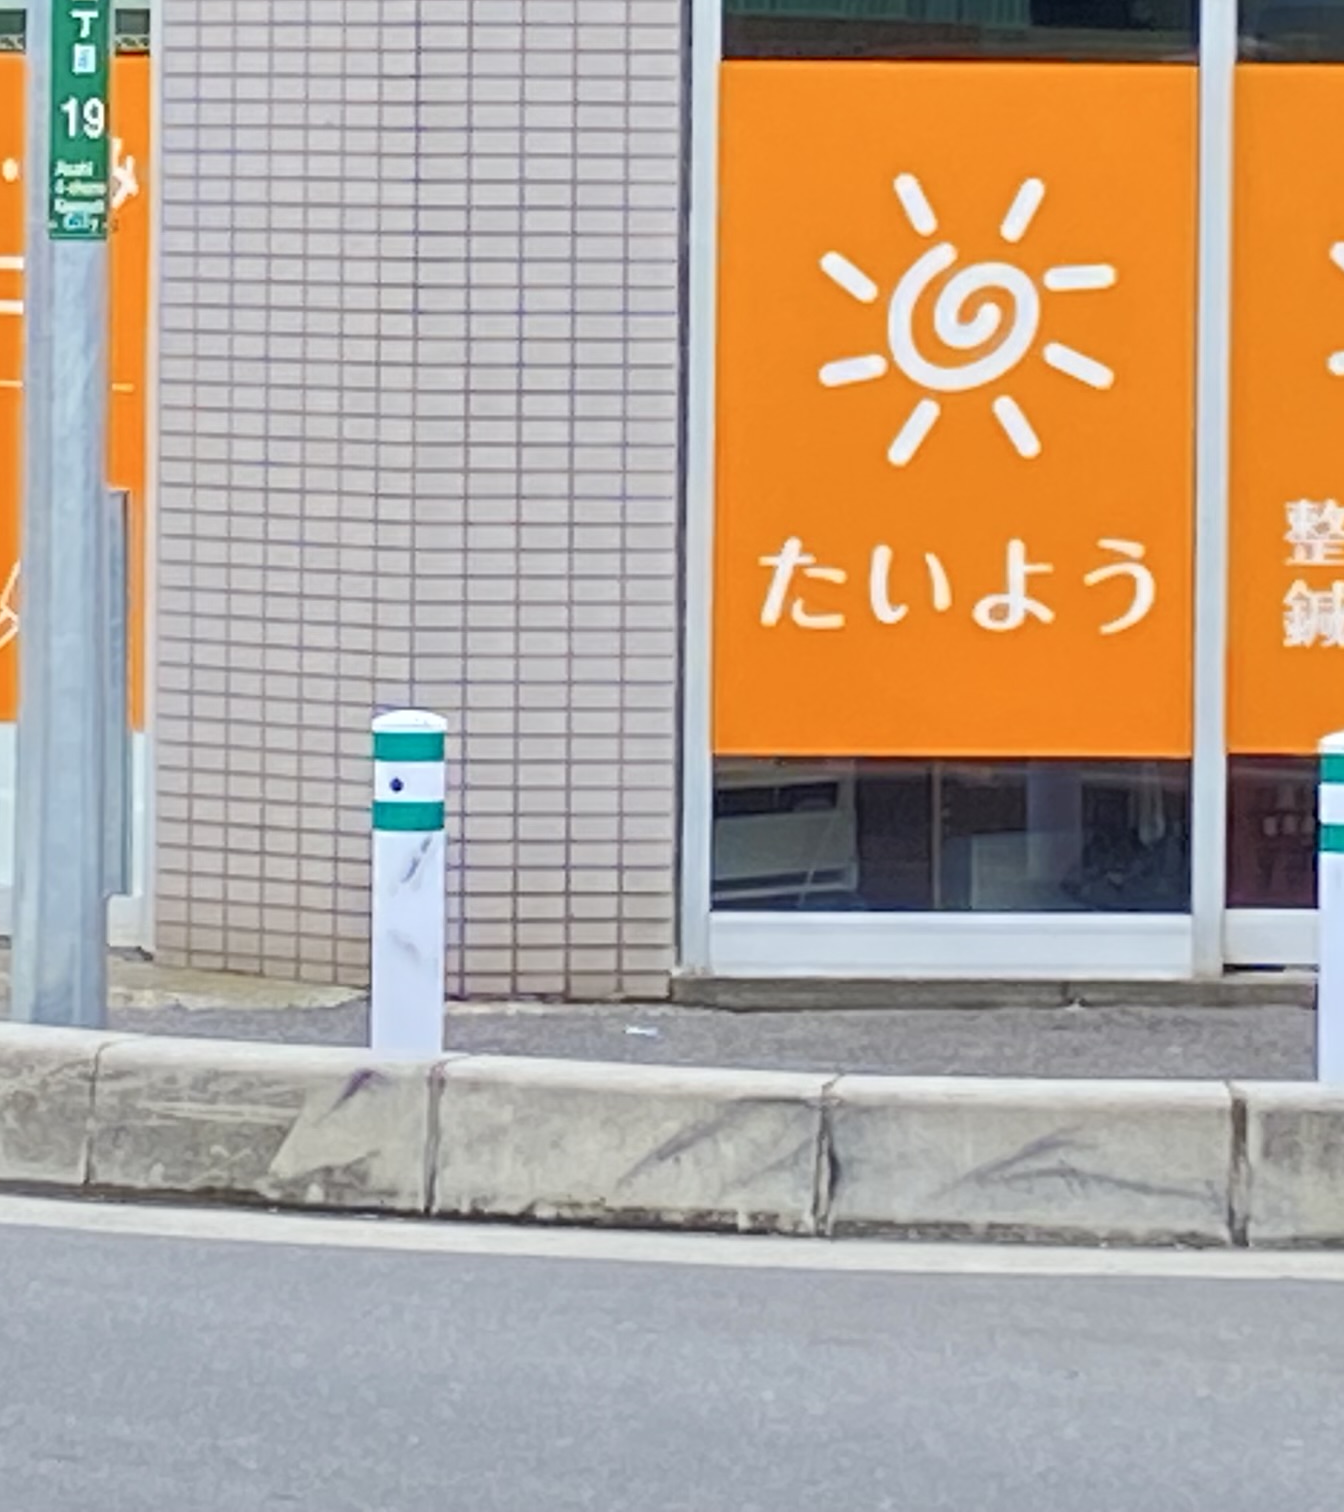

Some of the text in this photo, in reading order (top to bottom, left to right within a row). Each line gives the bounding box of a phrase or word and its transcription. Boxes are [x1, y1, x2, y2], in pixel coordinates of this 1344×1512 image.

[60, 96, 105, 139] 19
[758, 535, 1156, 635] たいよう
